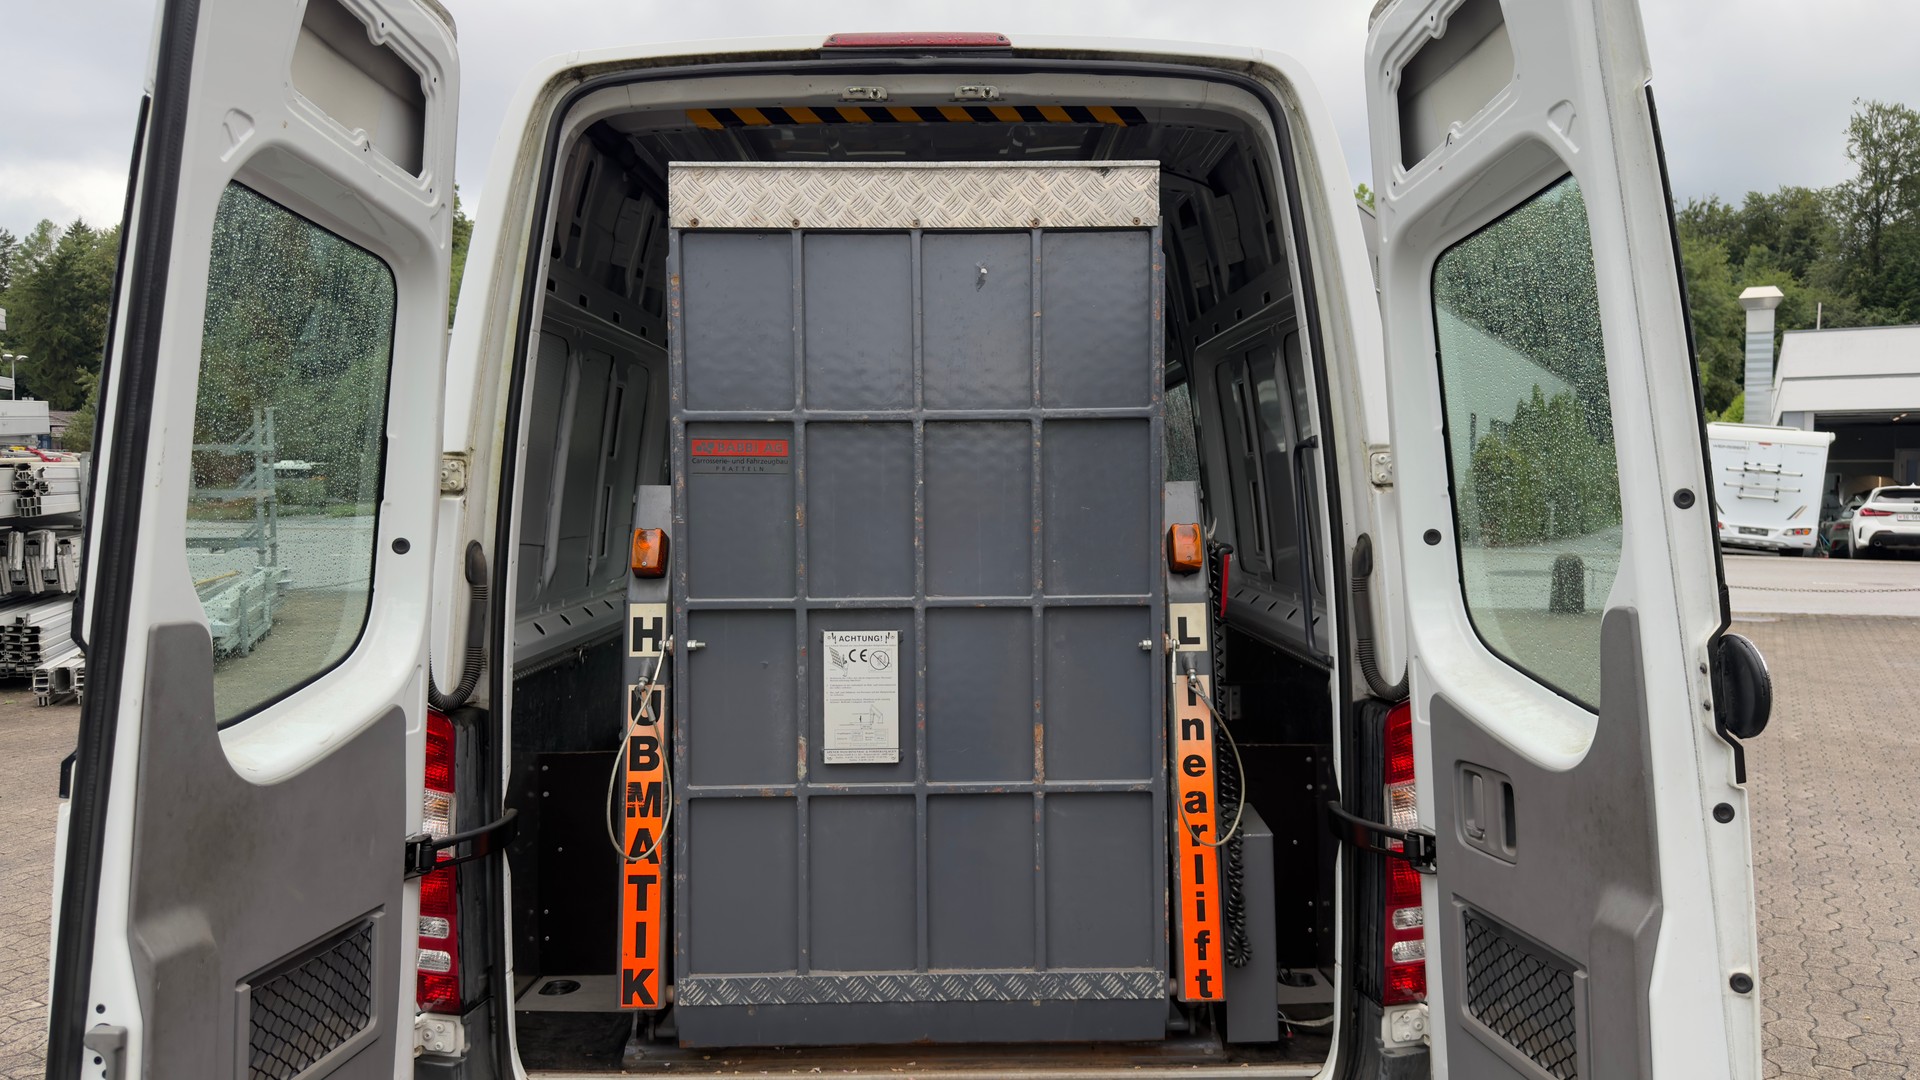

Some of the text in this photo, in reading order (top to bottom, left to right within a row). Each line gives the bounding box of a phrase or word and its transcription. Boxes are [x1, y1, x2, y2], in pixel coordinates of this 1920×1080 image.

[763, 442, 783, 453] AG
[691, 457, 789, 465] Carrosserie- und Fahrzeugbau
